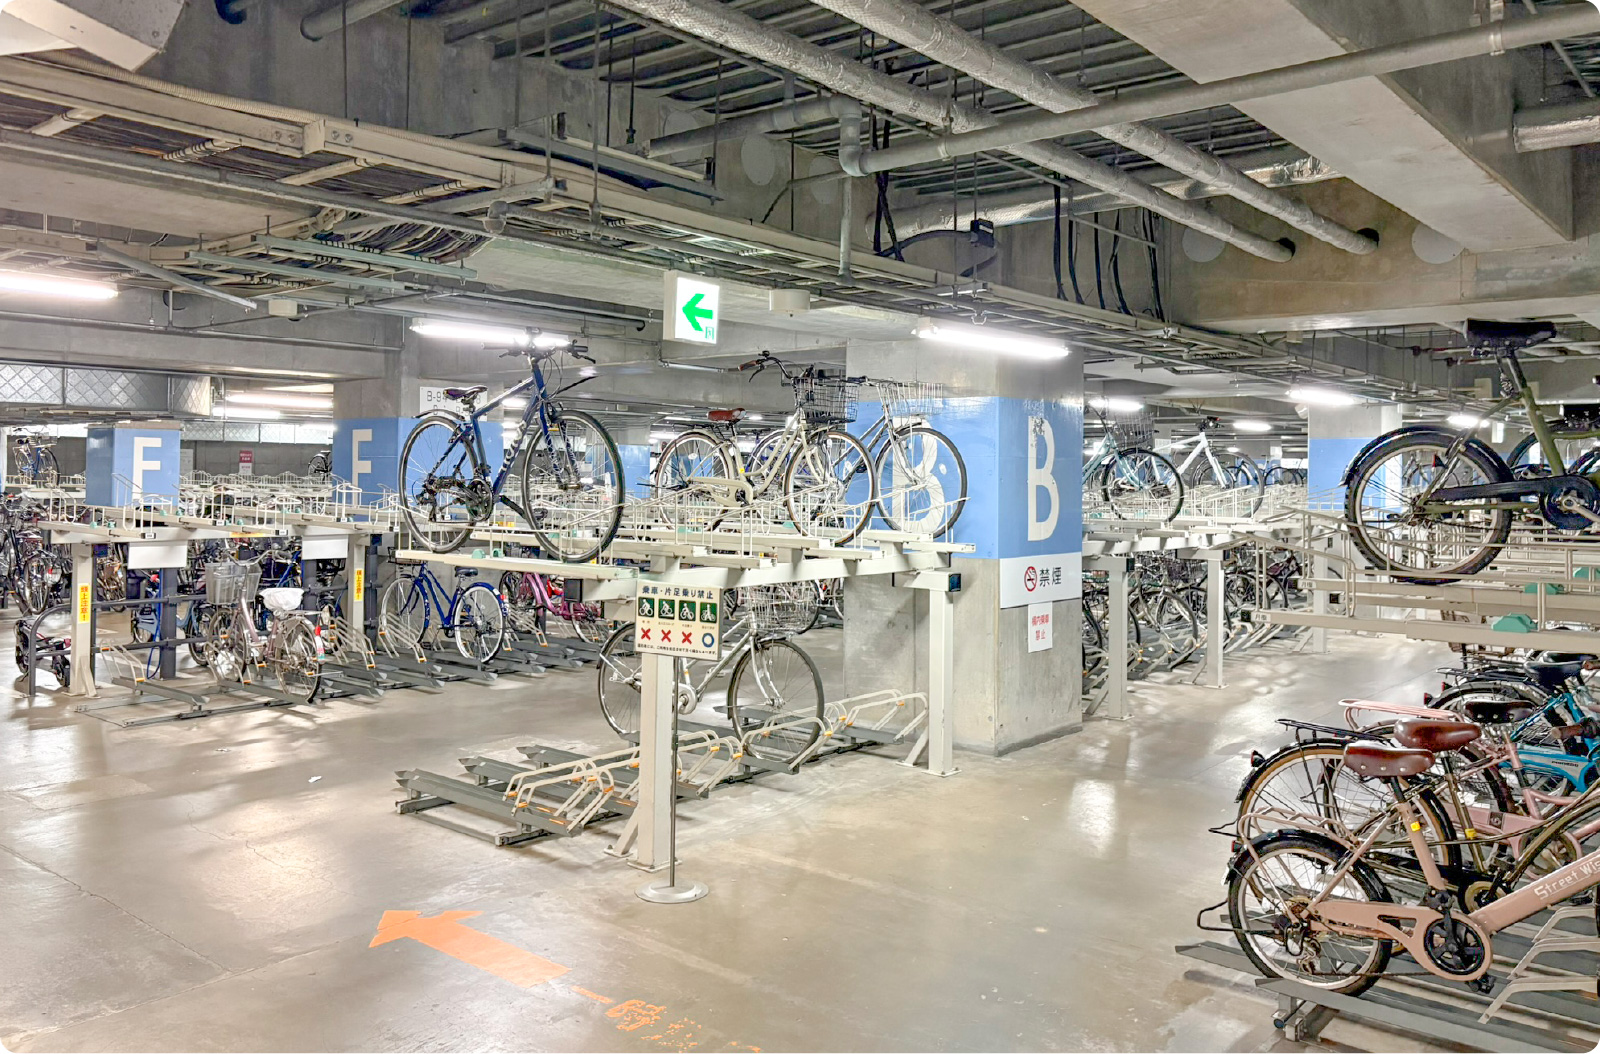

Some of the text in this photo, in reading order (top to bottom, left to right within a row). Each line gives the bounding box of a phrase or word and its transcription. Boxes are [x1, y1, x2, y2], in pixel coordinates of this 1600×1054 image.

[132, 436, 162, 501] F
[352, 428, 373, 508] F
[892, 415, 944, 535] B
[1028, 415, 1060, 542] B
[642, 585, 714, 600] 乗車・片足乗り禁止
[1039, 566, 1062, 588] 禁煙
[1534, 870, 1579, 900] Street
